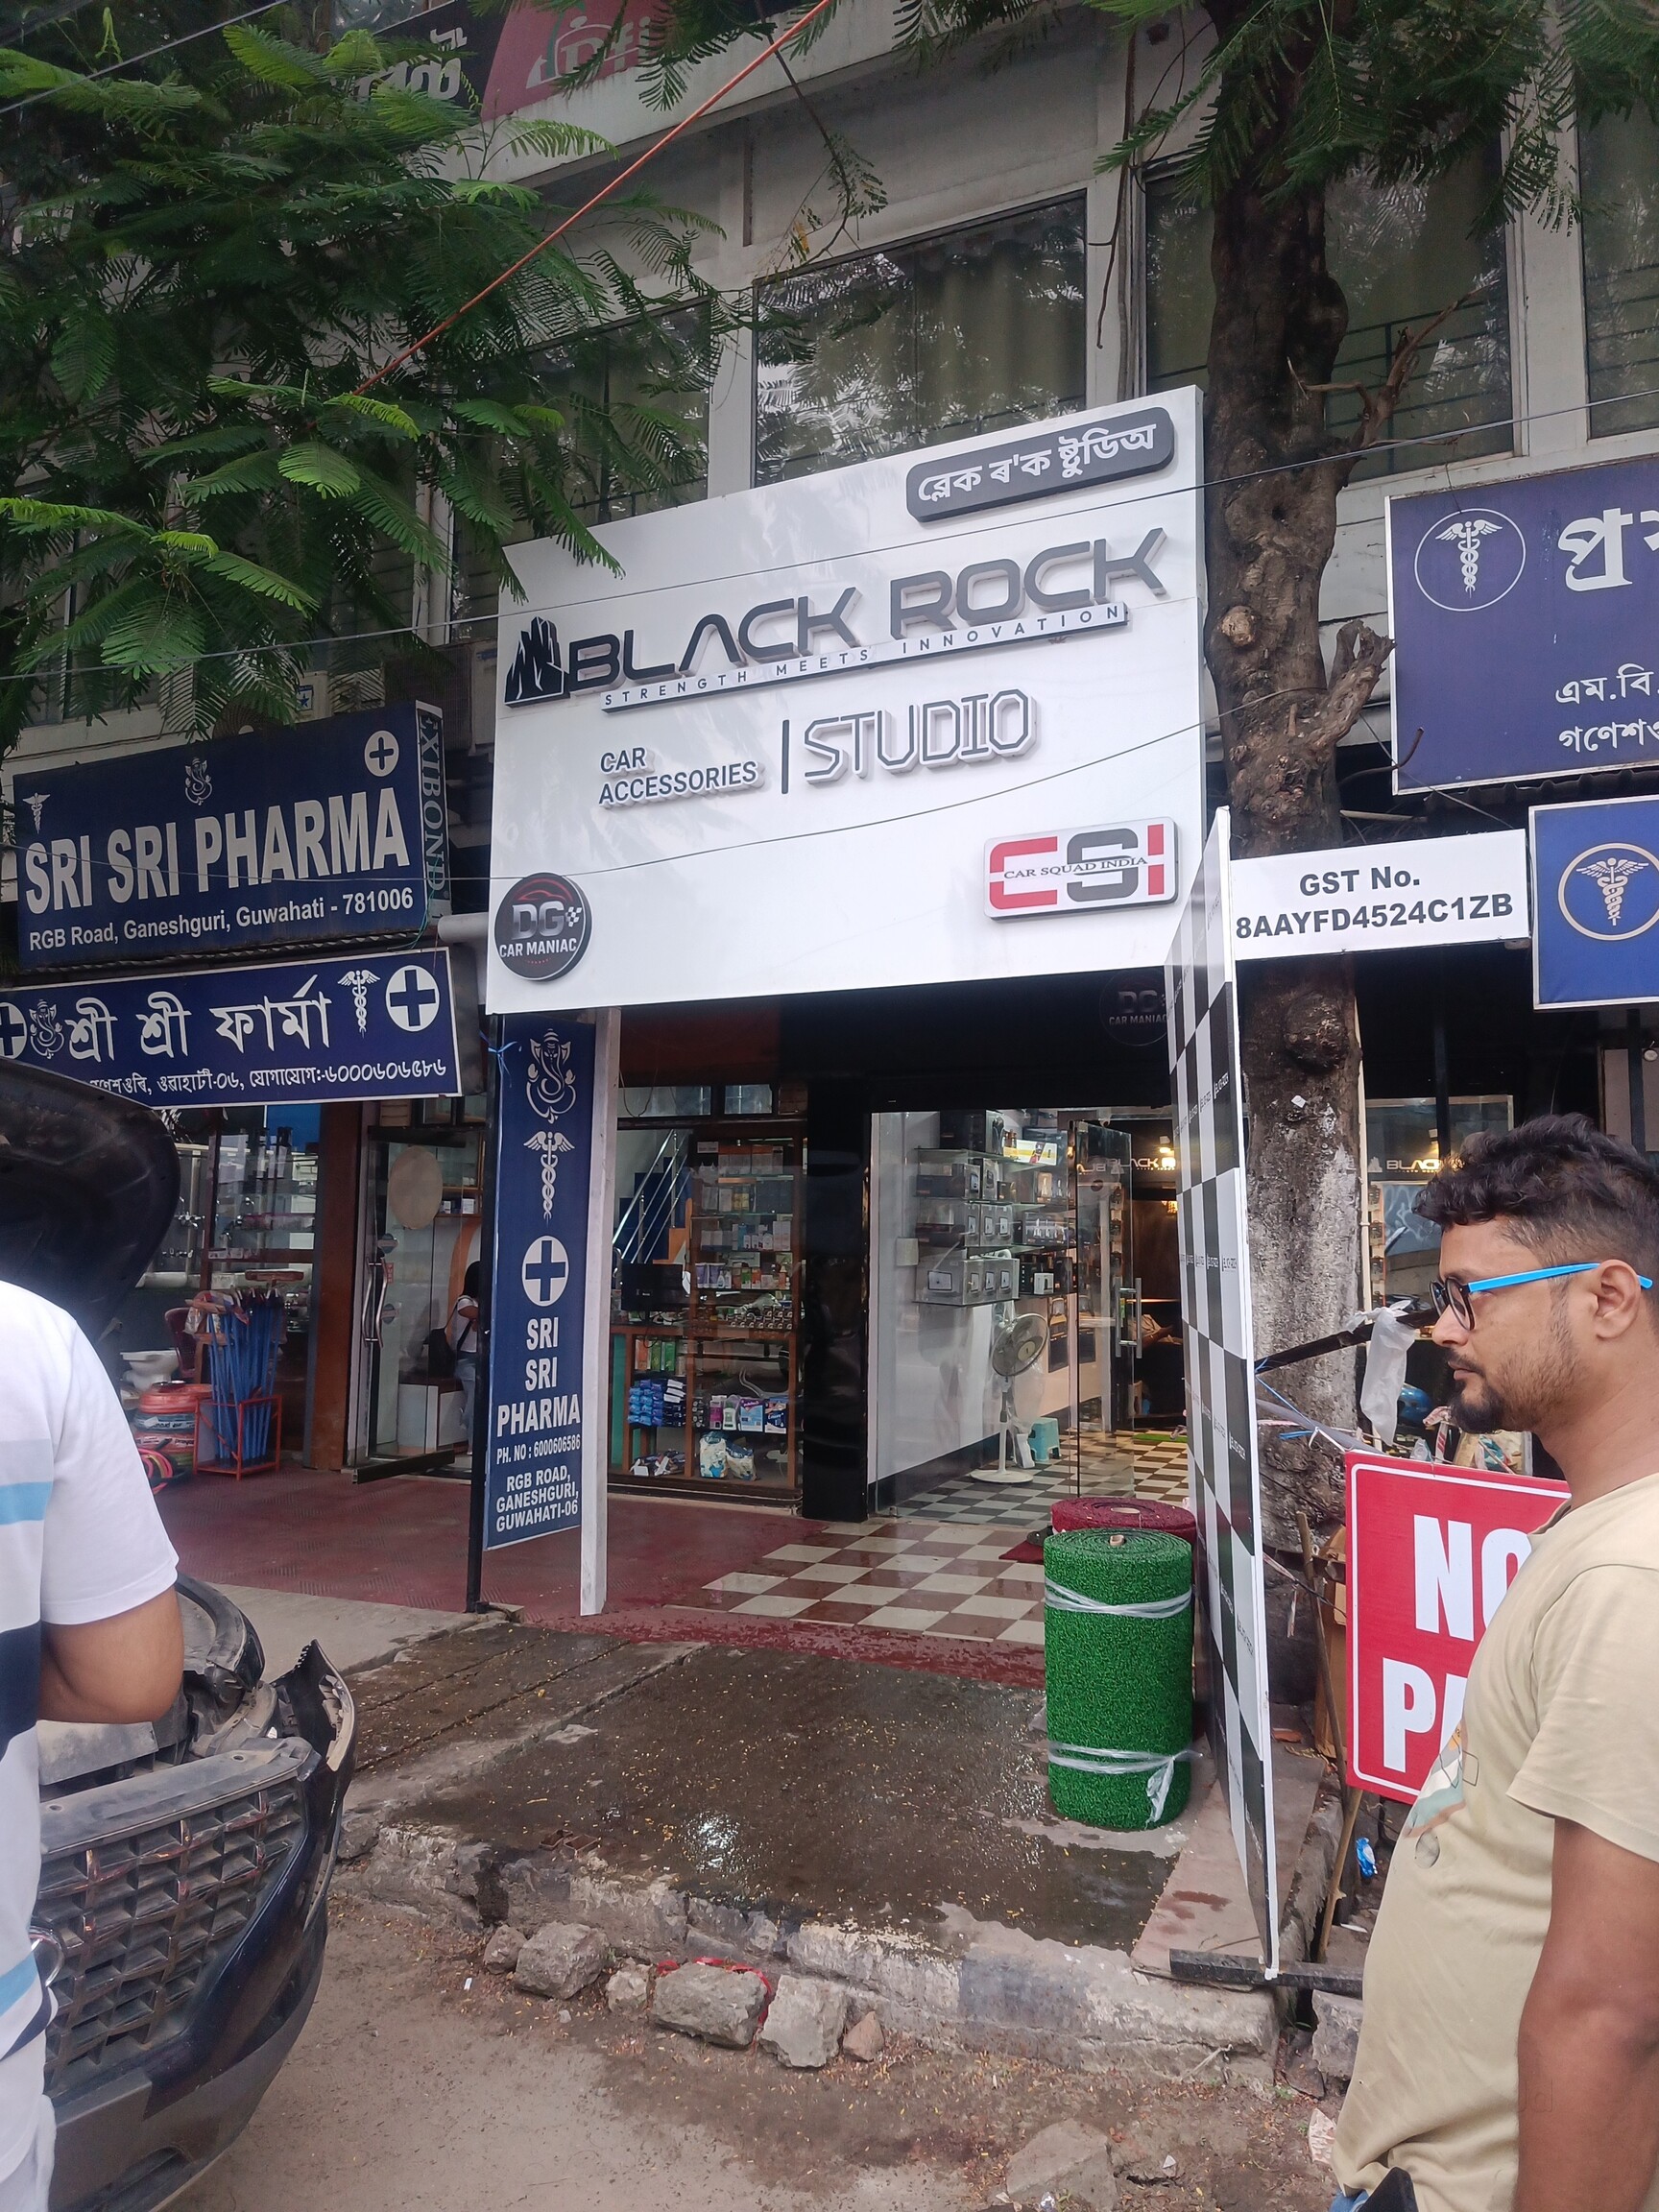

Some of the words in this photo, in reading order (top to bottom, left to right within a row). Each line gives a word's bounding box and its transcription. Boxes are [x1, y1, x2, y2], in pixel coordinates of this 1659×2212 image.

[569, 587, 862, 693] BLACK
[890, 527, 1166, 640] ROCK
[605, 670, 748, 707] STRENGTH
[776, 649, 869, 676] MEETS
[902, 605, 1118, 654] INNOVATION
[803, 687, 1032, 781] STUDIO
[600, 747, 647, 774] CAR
[598, 760, 758, 805] ACCESSORIES
[24, 834, 93, 915] SRI
[107, 821, 181, 904] SRI
[195, 786, 411, 894] PHARMA
[990, 823, 1165, 910] CSI
[1003, 869, 1037, 879] CAR
[1041, 862, 1096, 877] SQUAD
[1101, 856, 1148, 869] INDIA
[1299, 869, 1361, 896] GST
[1370, 865, 1421, 890] No.
[29, 929, 67, 951] RGB
[71, 926, 119, 947] Road,
[123, 910, 231, 940] Ganeshguri,
[236, 897, 325, 927] Guwahati
[342, 886, 415, 916] 781006
[512, 900, 565, 941] DG
[1235, 893, 1514, 940] 8AAYFD4524C1ZB
[499, 943, 523, 958] CAR
[526, 937, 577, 956] MANIAC
[526, 1316, 559, 1351] SRI
[525, 1357, 558, 1392] SRI
[496, 1393, 581, 1437] PHARMA
[496, 1448, 511, 1464] PH.
[514, 1443, 527, 1462] NO
[533, 1433, 581, 1457] 6000606586
[496, 1481, 579, 1514] GANESHGURI,
[506, 1473, 532, 1493] RGB
[536, 1464, 571, 1486] ROAD,
[496, 1499, 579, 1533] GUWAHATI-06
[1413, 1513, 1532, 1642] NO
